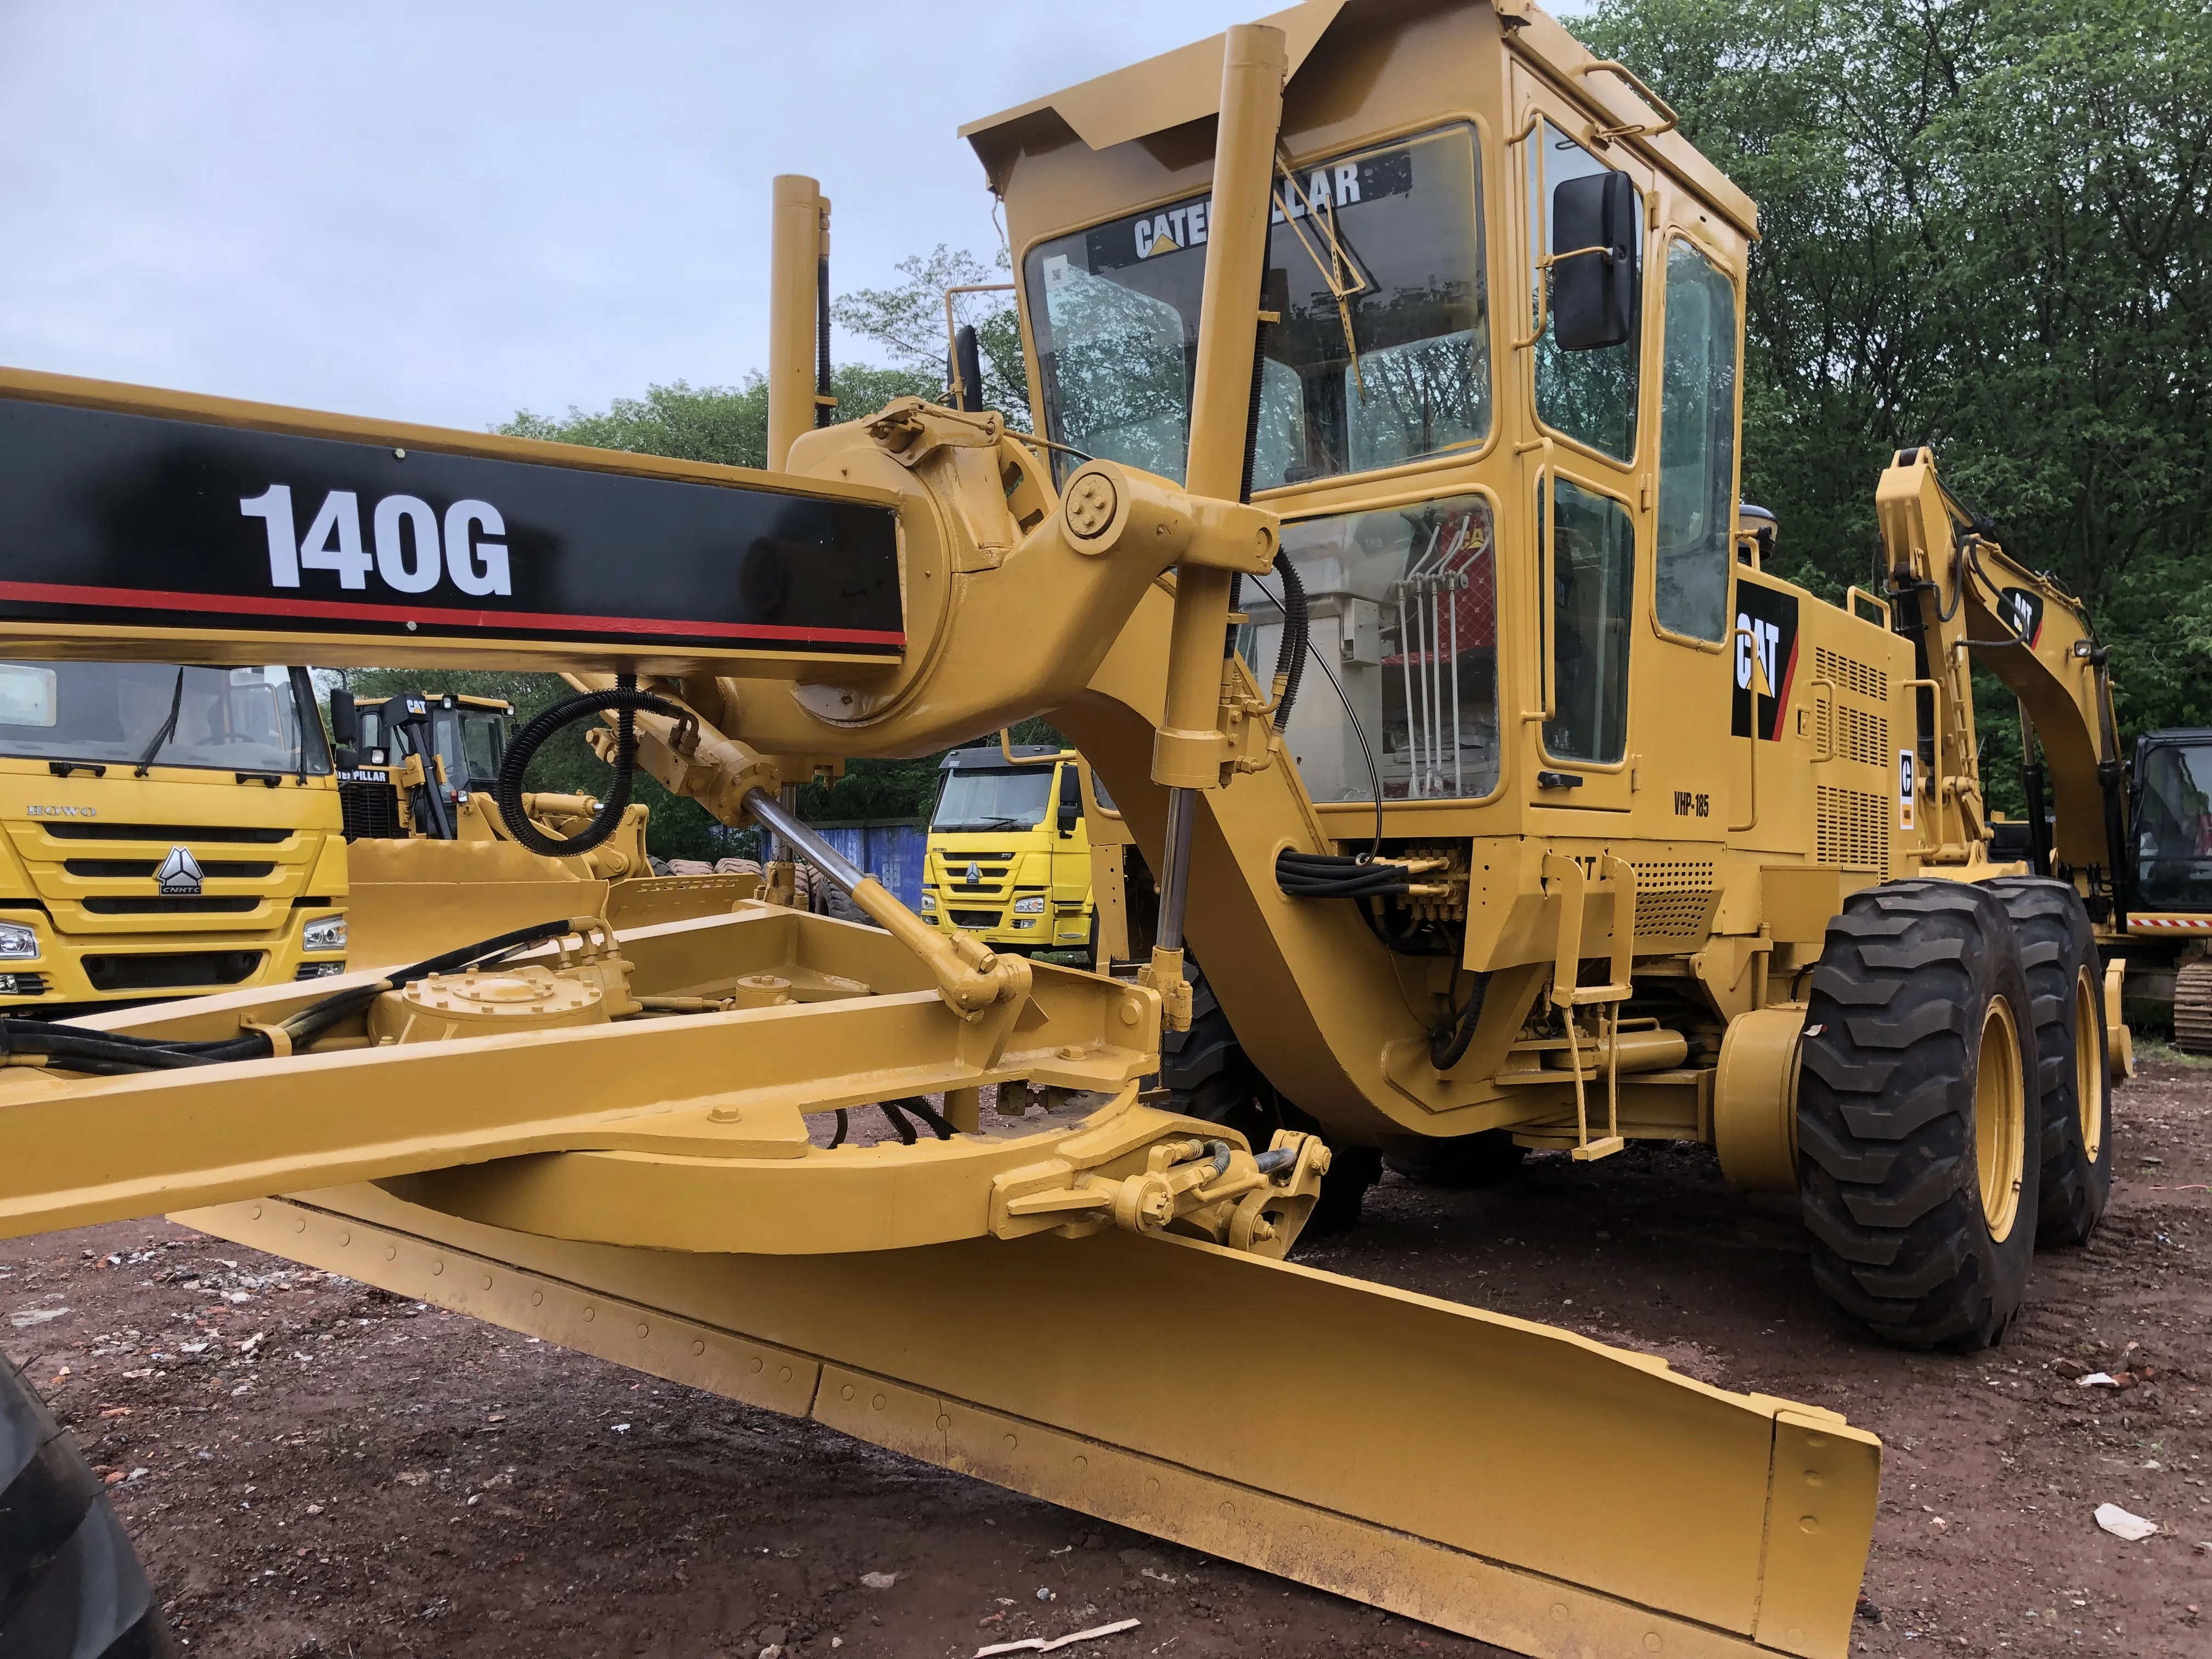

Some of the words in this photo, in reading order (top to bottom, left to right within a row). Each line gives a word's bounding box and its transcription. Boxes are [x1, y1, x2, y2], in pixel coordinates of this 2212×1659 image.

[1134, 163, 1361, 259] CATELAR
[239, 484, 512, 596] 140G
[1736, 612, 1779, 699] CAT
[406, 699, 426, 714] CAT
[26, 805, 97, 816] HOWO
[1674, 791, 1709, 817] VHP-185
